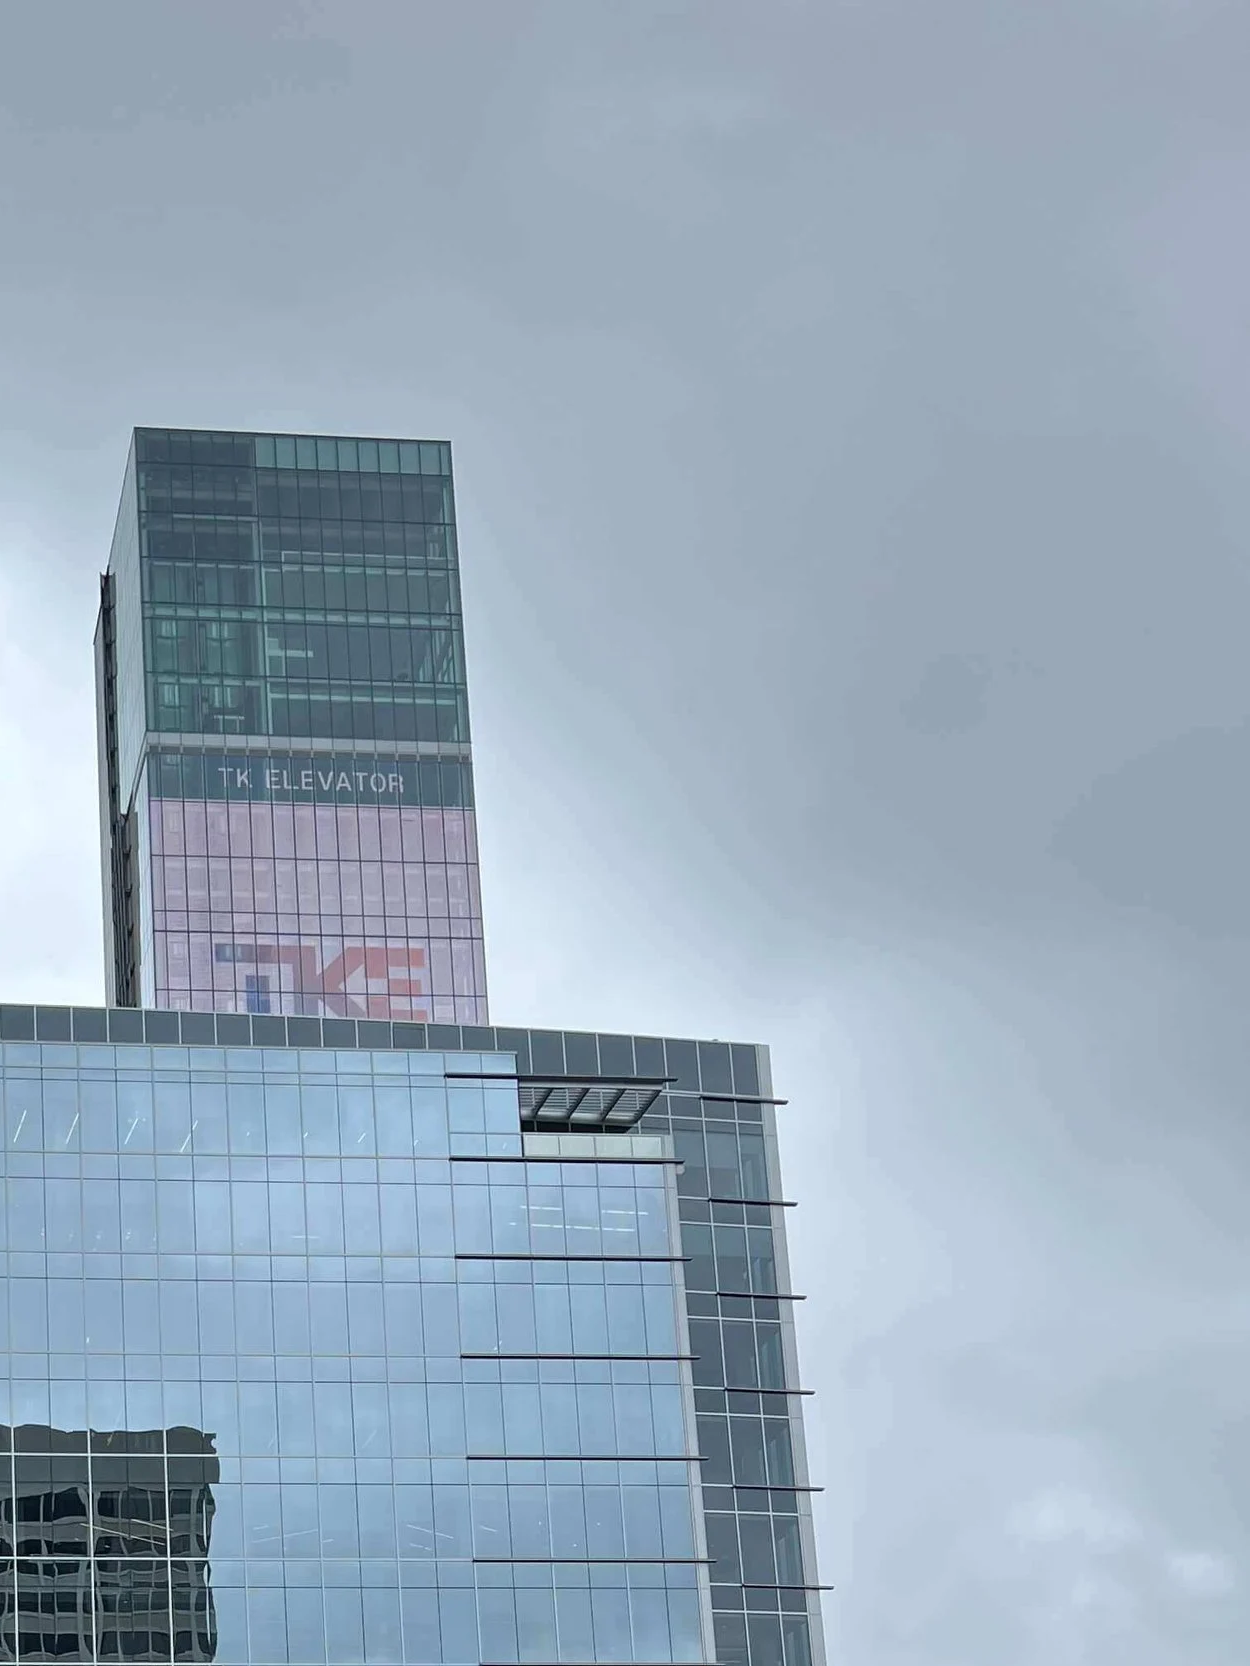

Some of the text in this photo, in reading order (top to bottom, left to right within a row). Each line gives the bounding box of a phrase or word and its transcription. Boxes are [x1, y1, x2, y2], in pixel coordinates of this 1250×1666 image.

[217, 767, 405, 794] TK ELEVATOR
[215, 943, 429, 1022] TKE
